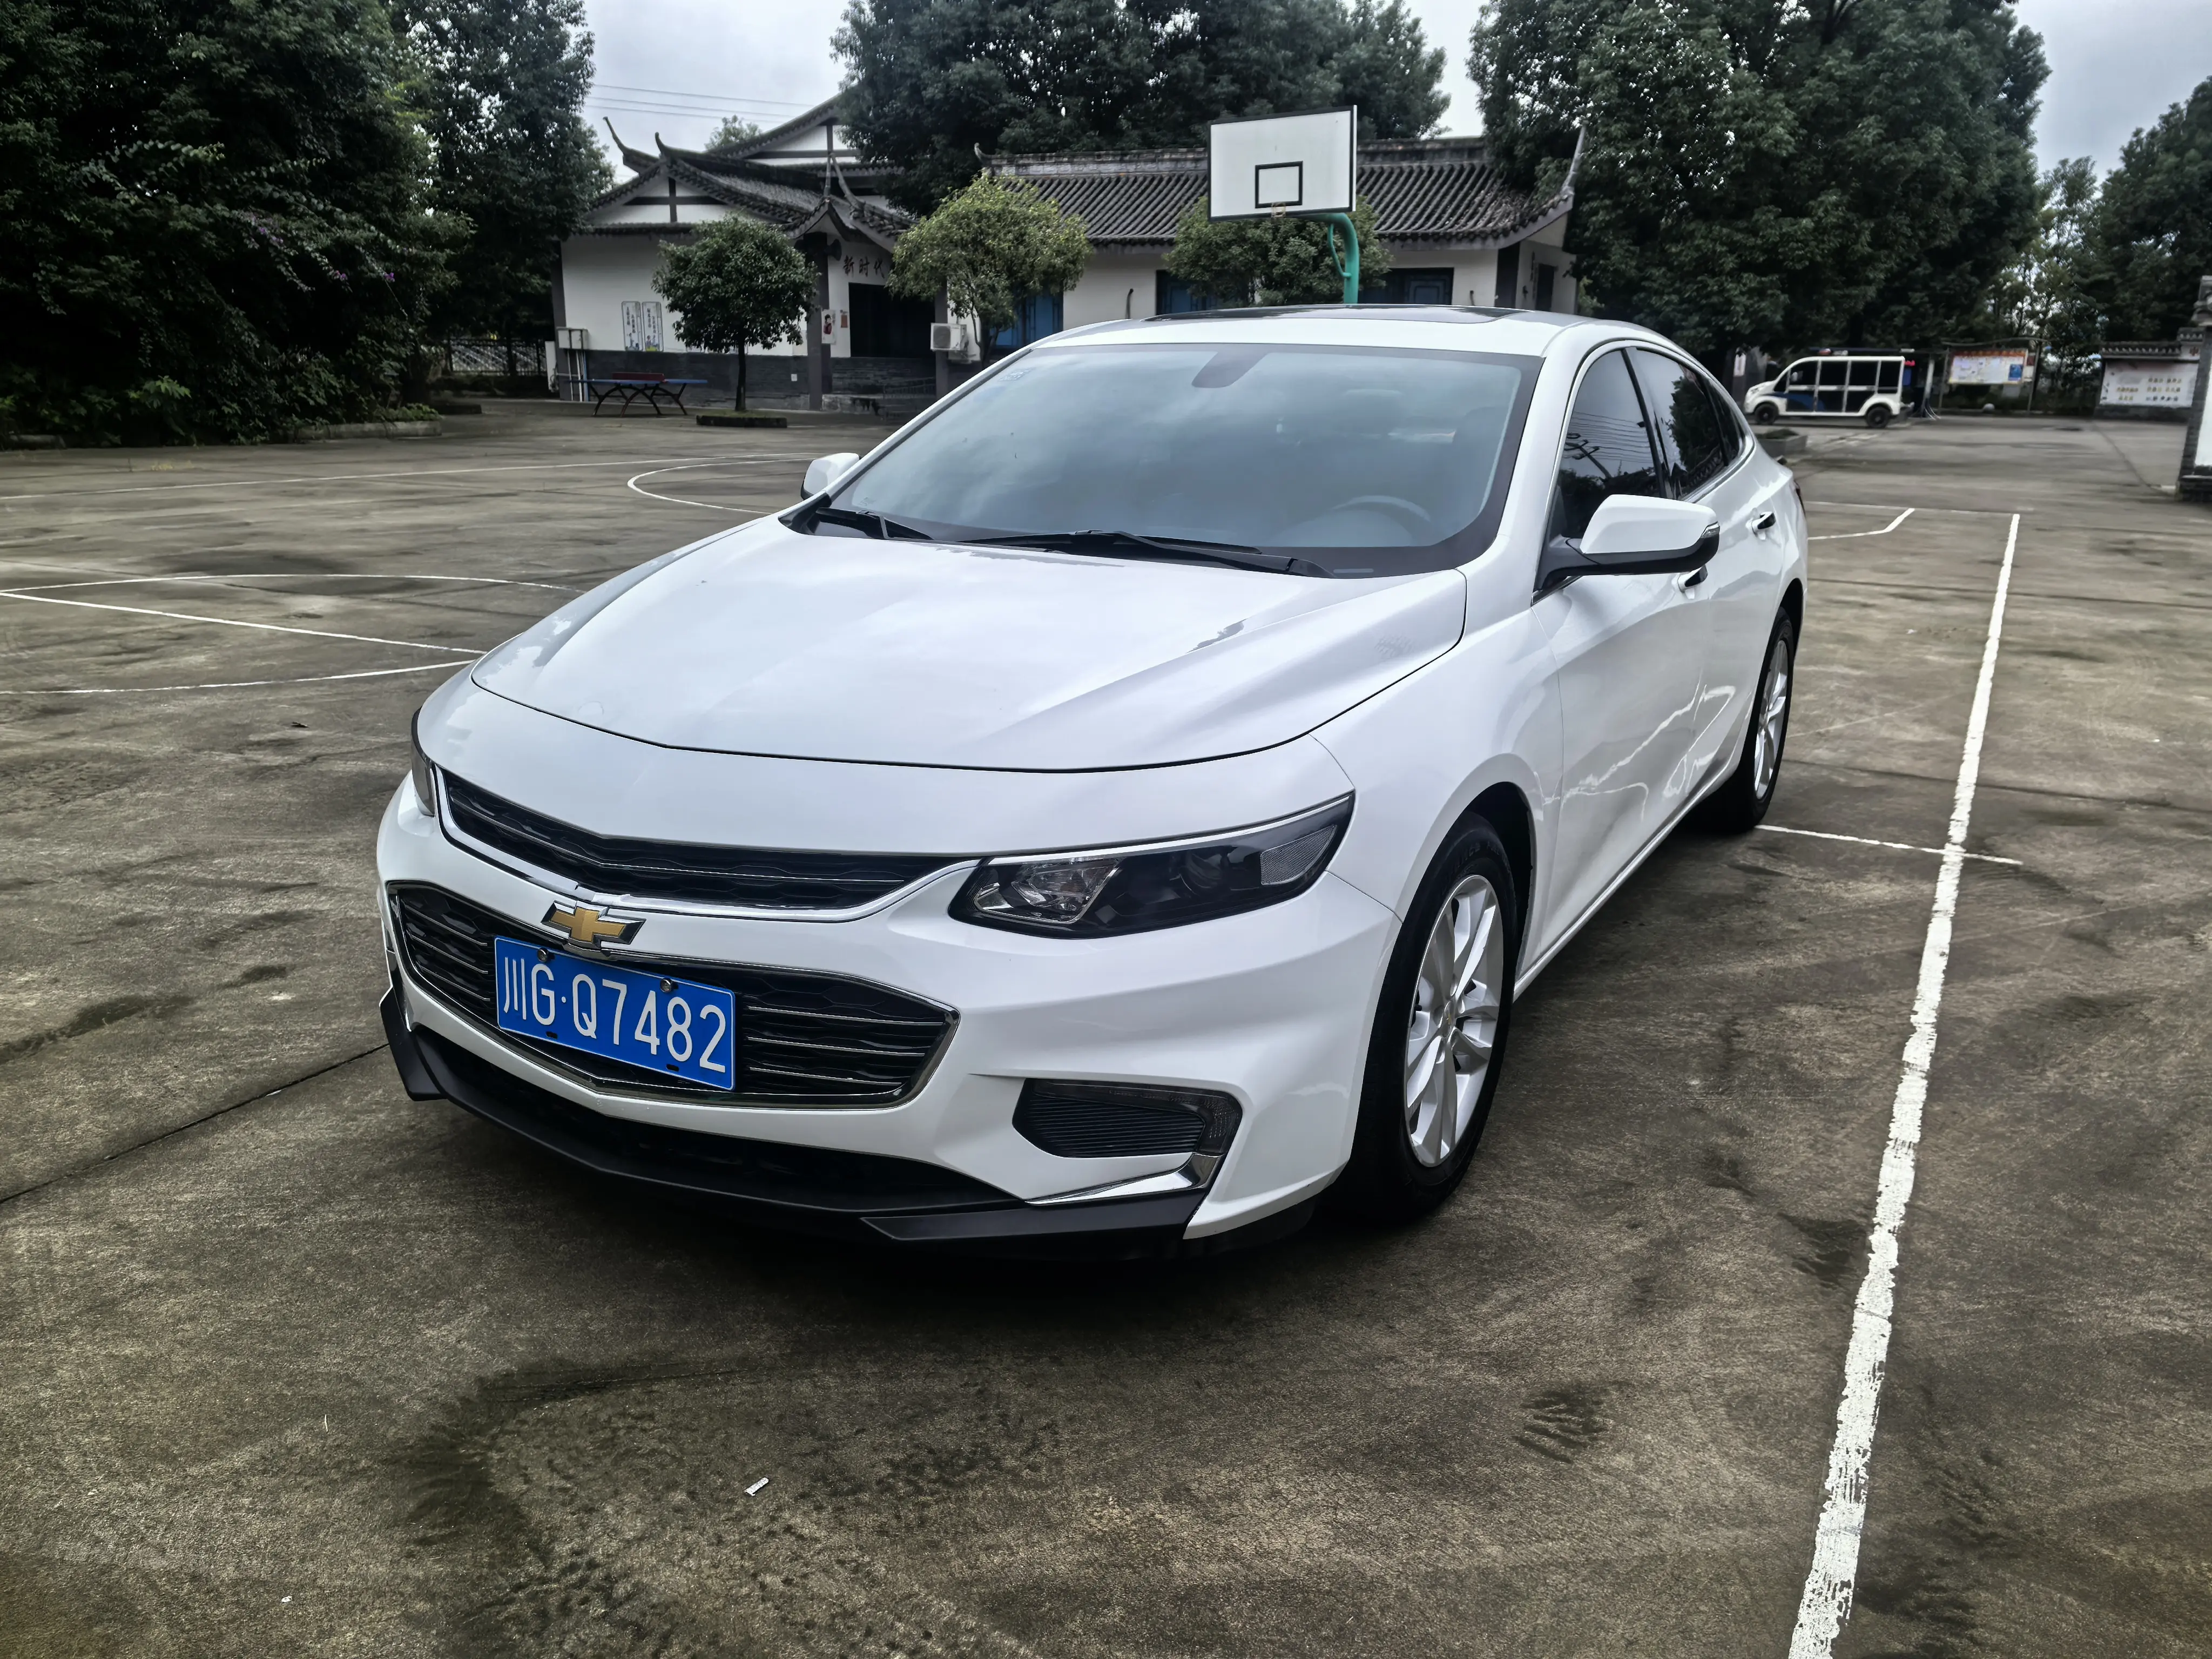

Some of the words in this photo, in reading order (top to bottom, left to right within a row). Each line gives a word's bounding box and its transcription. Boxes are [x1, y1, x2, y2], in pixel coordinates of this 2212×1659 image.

[843, 255, 885, 279] 新时代
[504, 956, 726, 1074] 川G·Q7482
